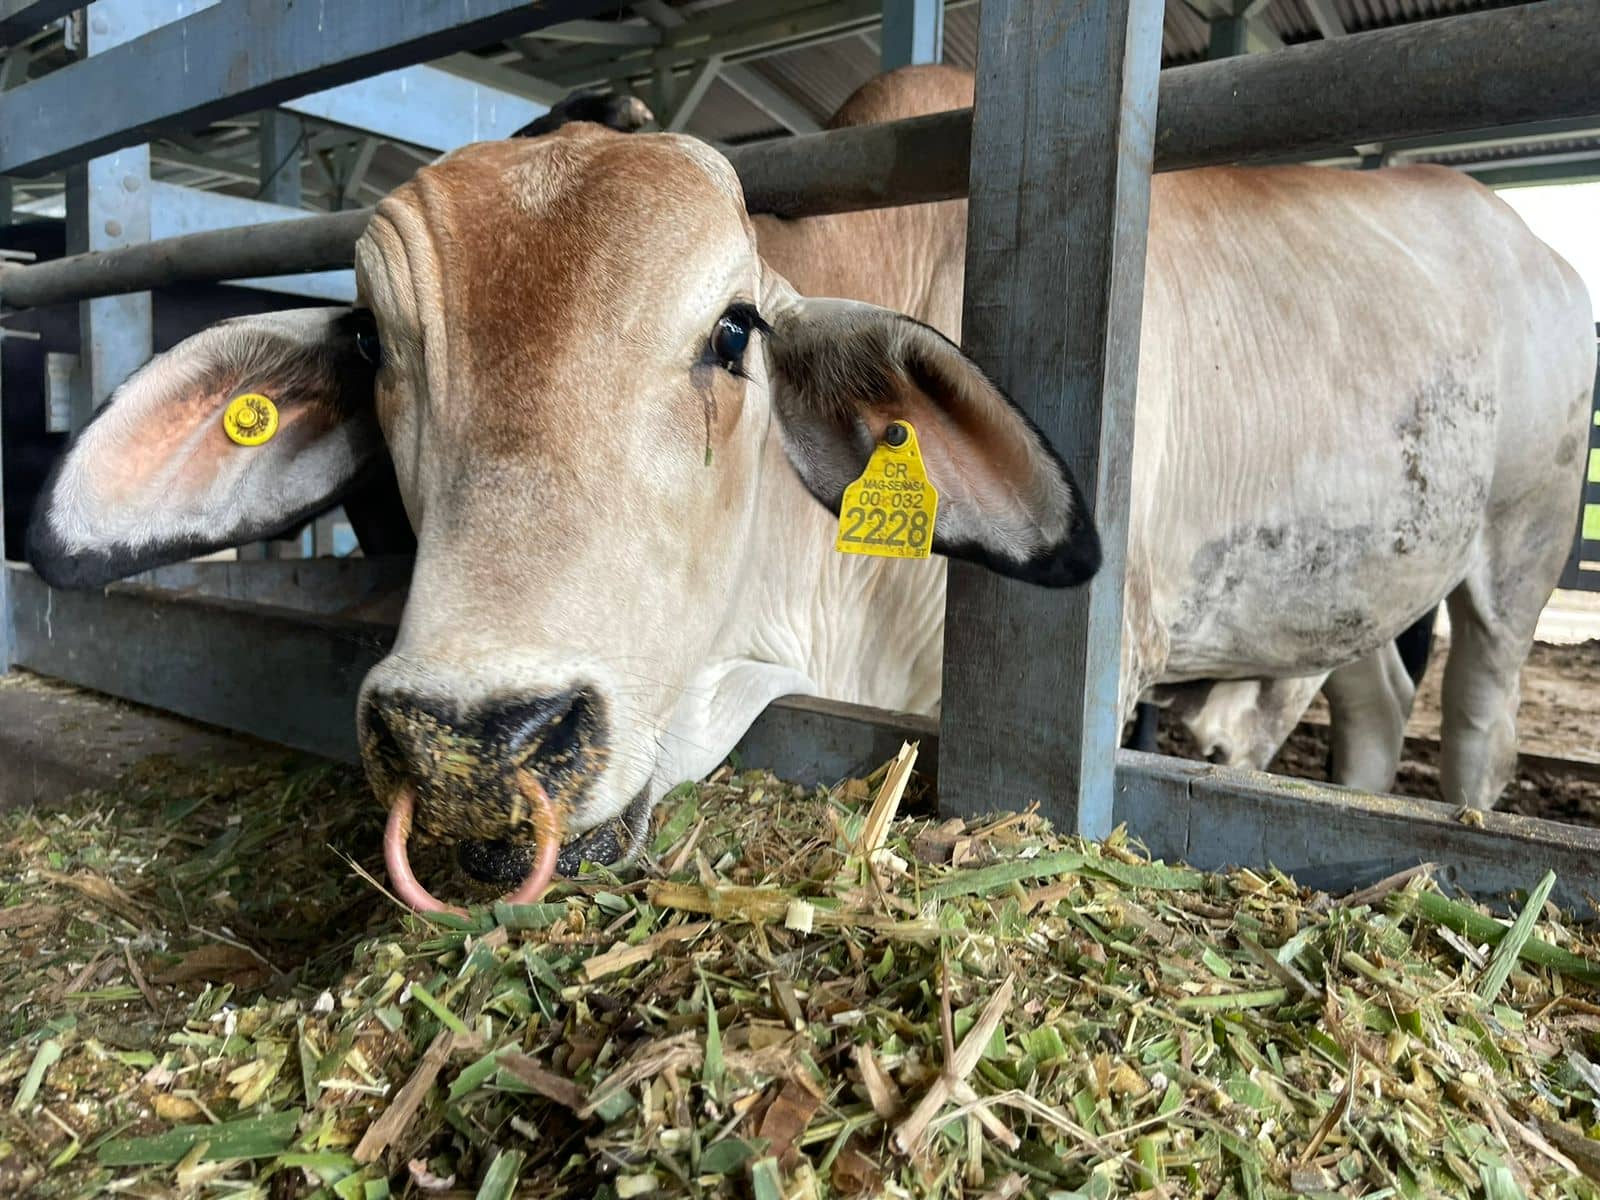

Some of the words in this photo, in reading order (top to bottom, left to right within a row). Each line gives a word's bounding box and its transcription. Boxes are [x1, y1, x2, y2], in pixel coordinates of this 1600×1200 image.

[884, 463, 908, 479] CR
[859, 491, 881, 507] 00
[891, 493, 924, 509] 032
[841, 507, 928, 547] 2228
